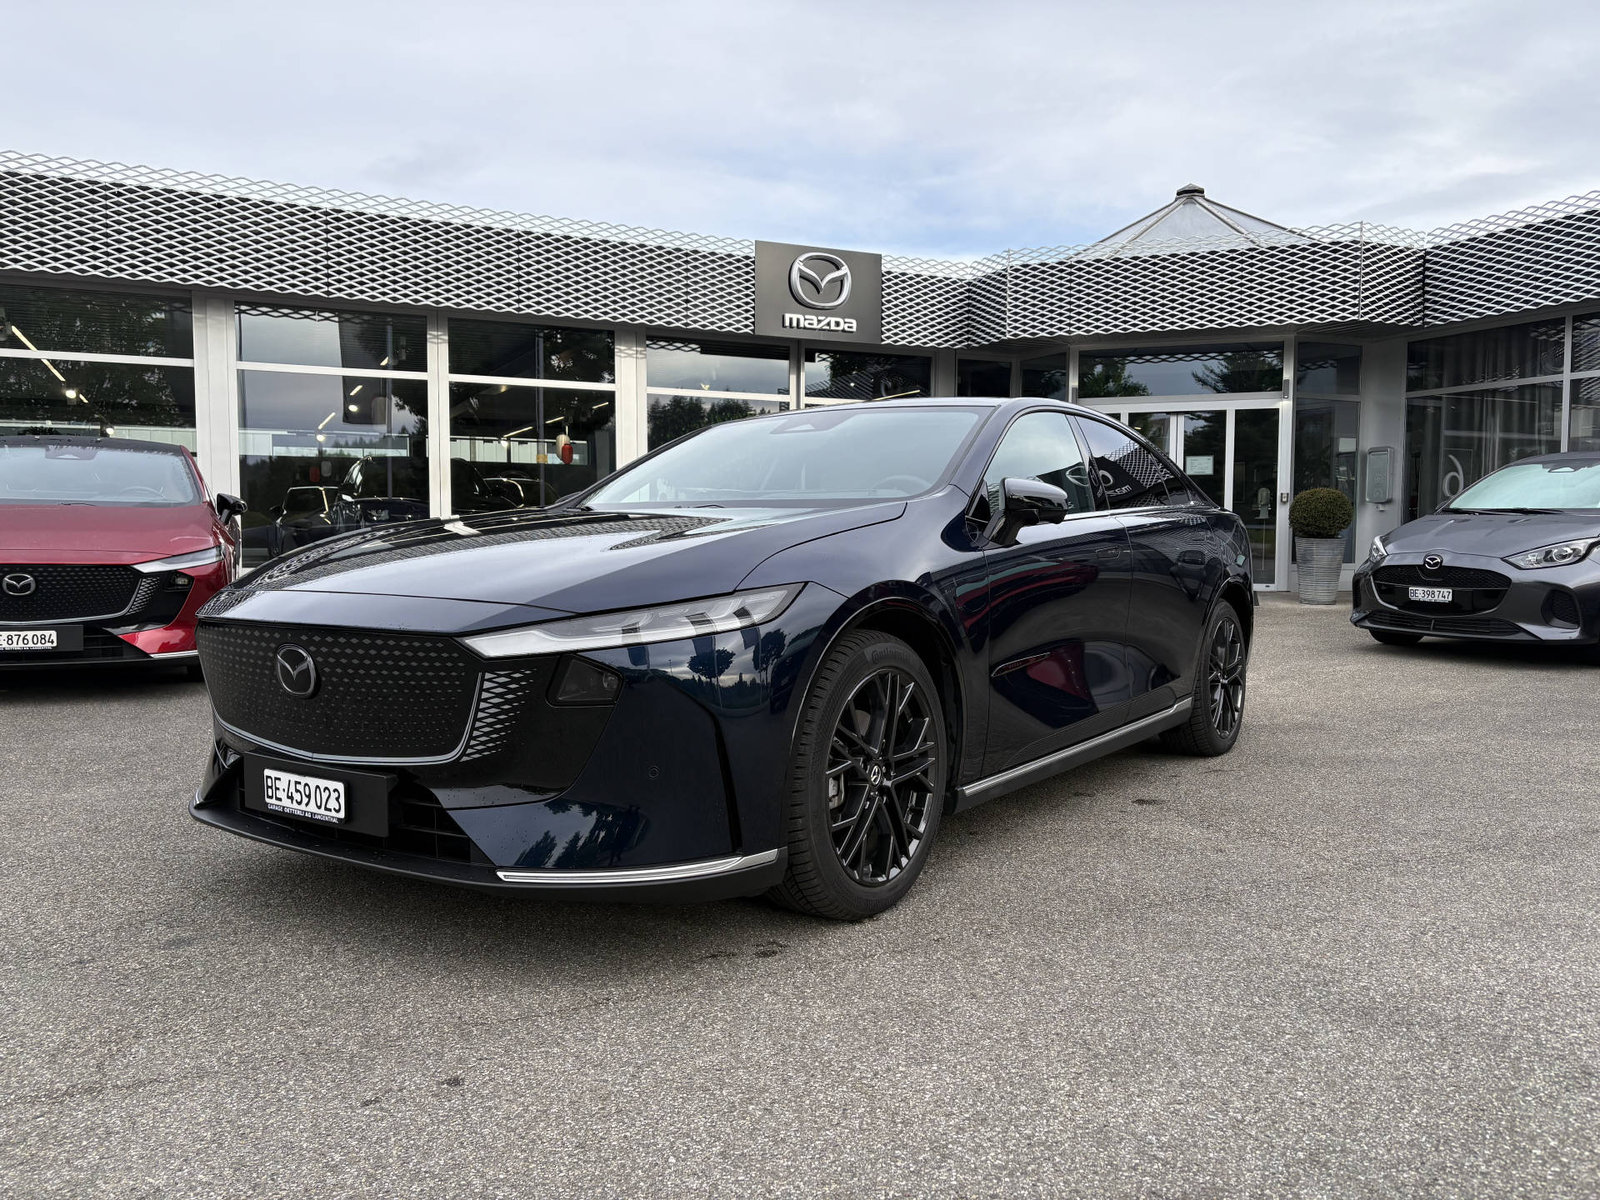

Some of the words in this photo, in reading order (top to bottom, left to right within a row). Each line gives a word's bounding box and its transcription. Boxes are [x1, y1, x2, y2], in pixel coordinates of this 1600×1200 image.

[783, 313, 857, 332] mazda
[1437, 591, 1451, 600] 747
[32, 633, 54, 645] 084
[314, 784, 341, 813] 023
[267, 803, 283, 812] GARAGE
[284, 807, 304, 816] OETTERLI
[312, 812, 339, 823] LANGENTHAL
